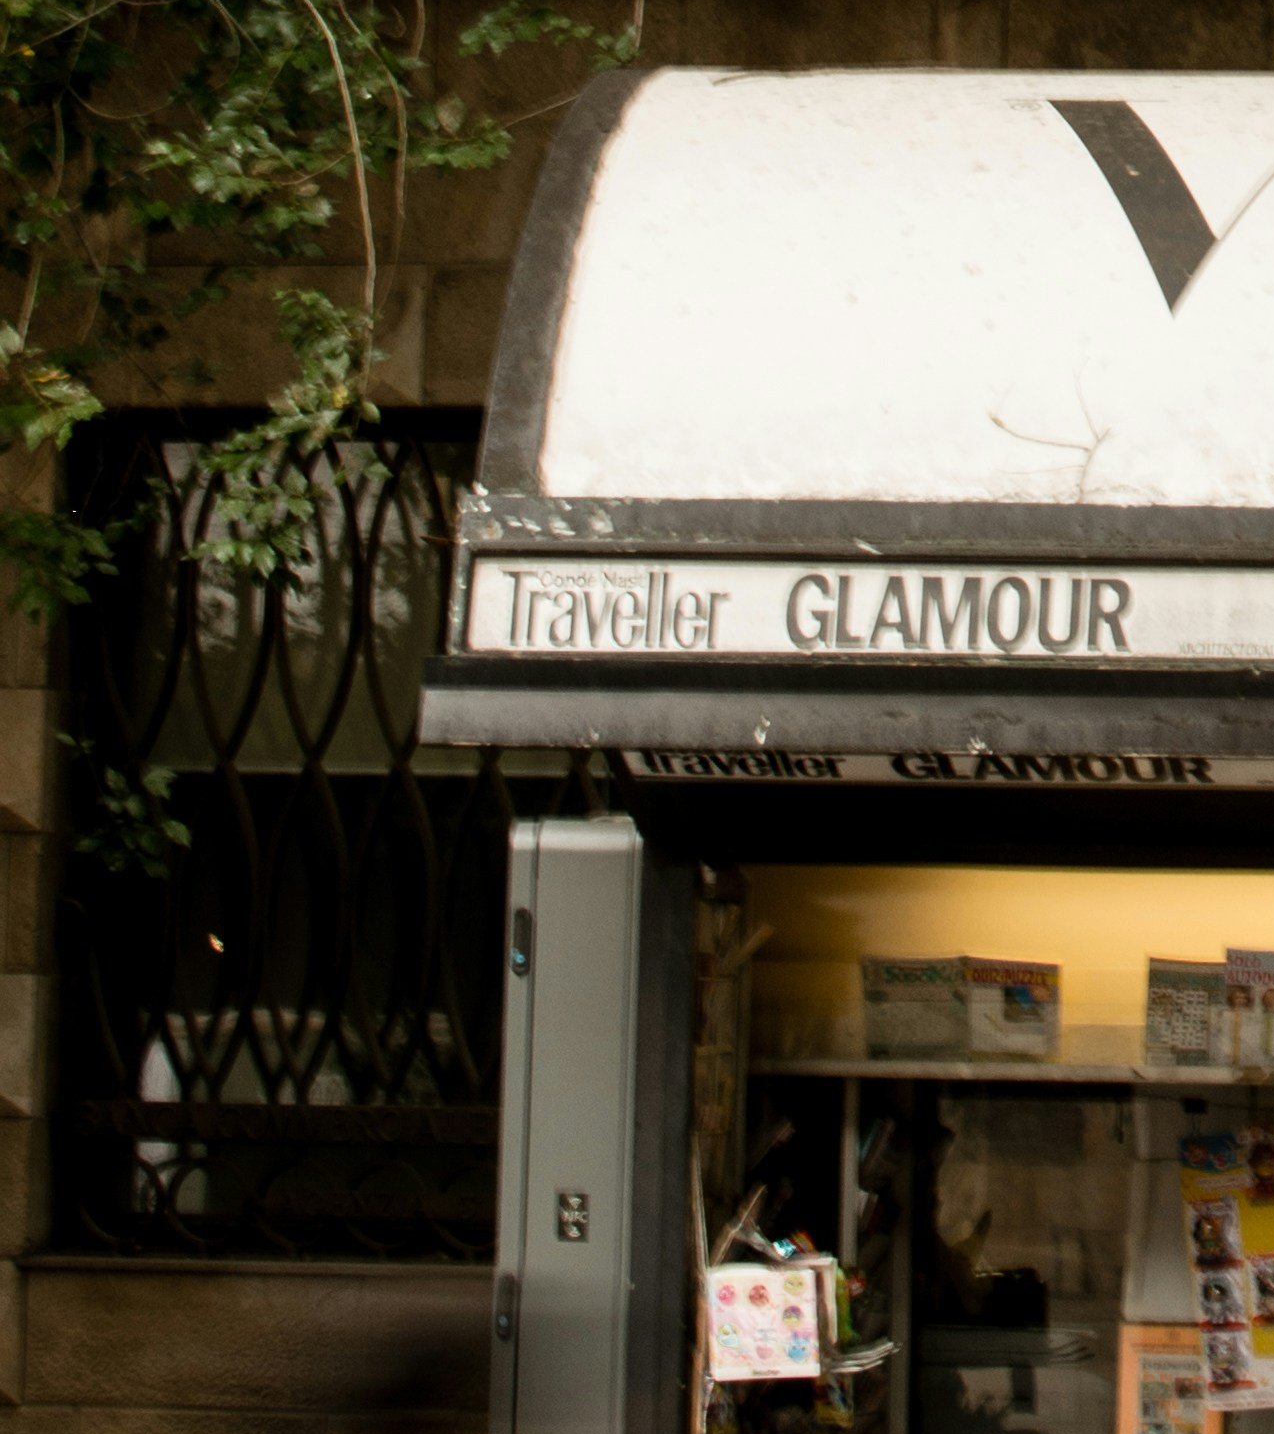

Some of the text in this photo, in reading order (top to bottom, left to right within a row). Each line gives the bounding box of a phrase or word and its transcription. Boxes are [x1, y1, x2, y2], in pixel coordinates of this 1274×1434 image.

[602, 570, 646, 590] Nast
[501, 569, 732, 650] Traveller
[787, 573, 1132, 653] GLAMOUR
[891, 752, 1216, 785] GLAMOUR
